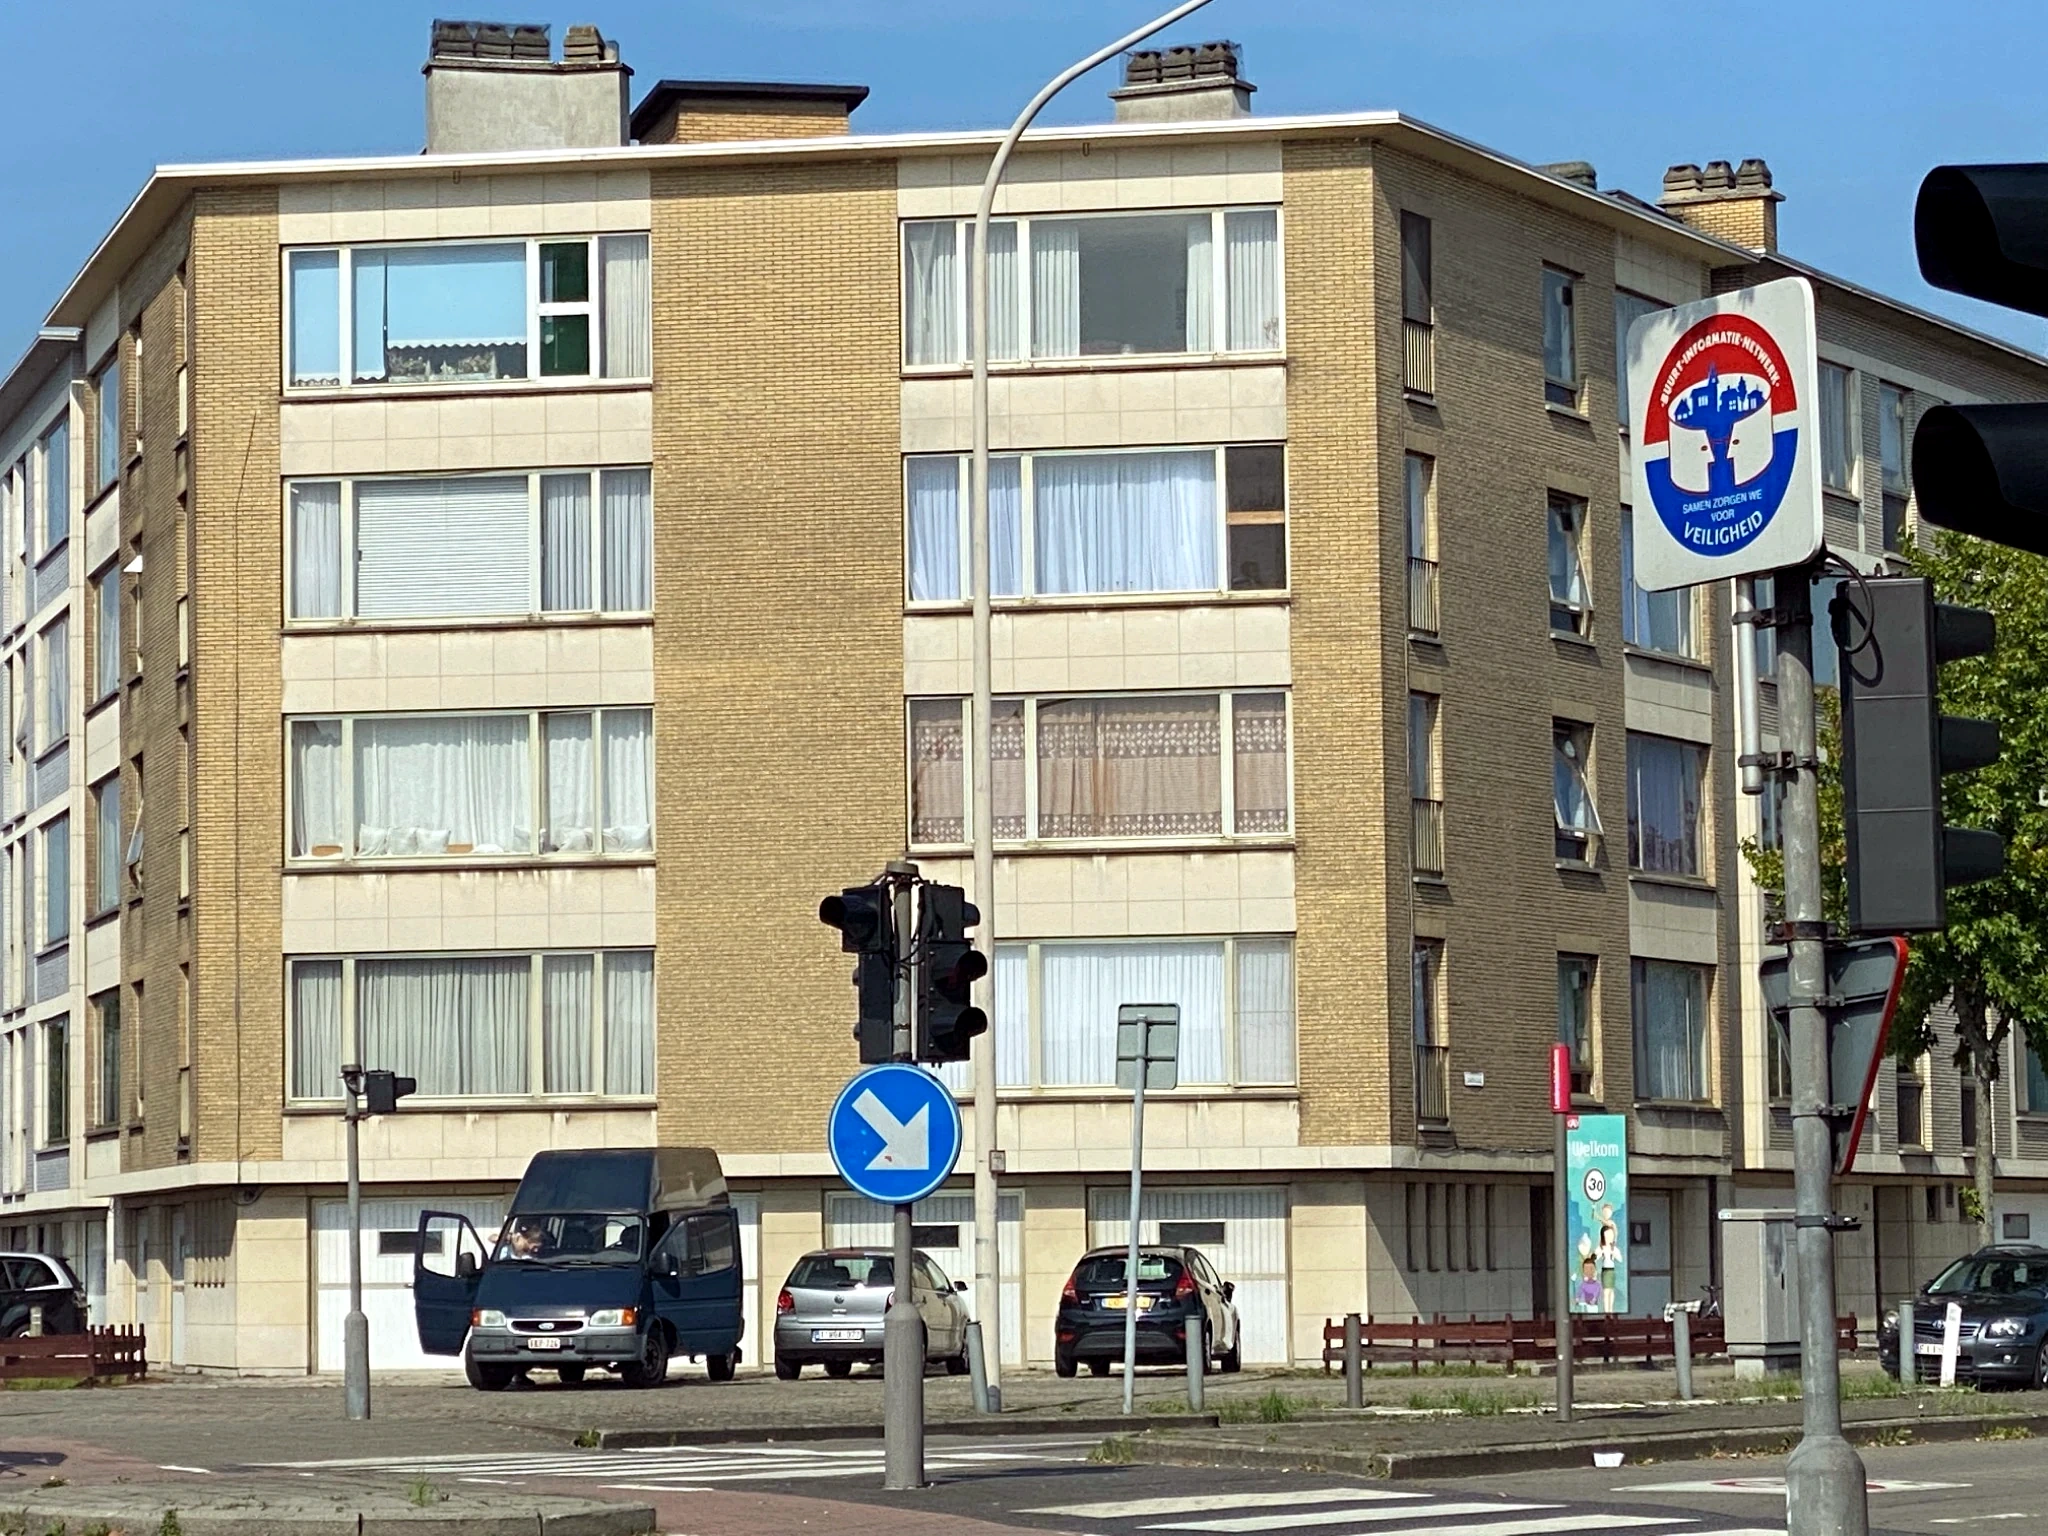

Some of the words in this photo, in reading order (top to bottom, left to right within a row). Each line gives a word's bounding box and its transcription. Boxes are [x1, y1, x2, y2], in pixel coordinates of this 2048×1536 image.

[1682, 499, 1712, 515] SAMEN
[1712, 491, 1747, 509] ZORGEN
[1748, 488, 1763, 501] WE
[1710, 508, 1735, 522] VOOR
[1684, 510, 1763, 546] VEILIGHEID
[1571, 1140, 1619, 1157] Welkom
[1588, 1178, 1603, 1192] 30
